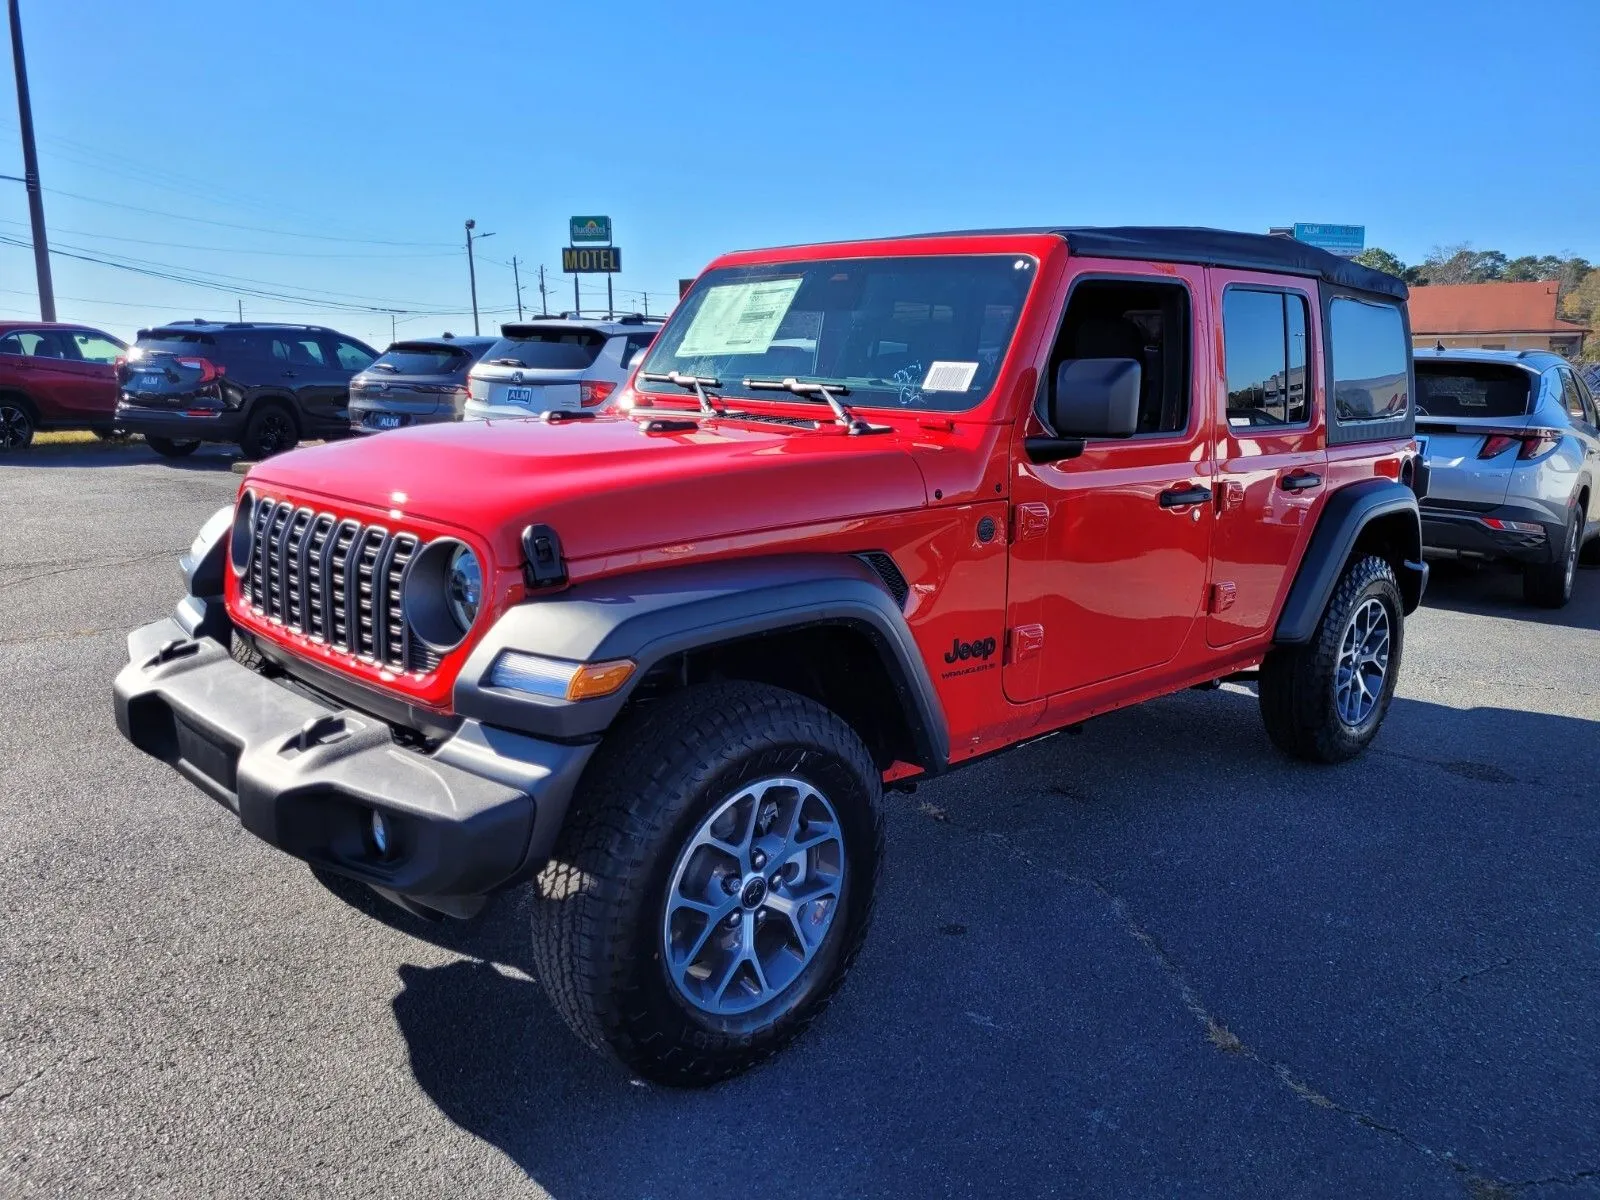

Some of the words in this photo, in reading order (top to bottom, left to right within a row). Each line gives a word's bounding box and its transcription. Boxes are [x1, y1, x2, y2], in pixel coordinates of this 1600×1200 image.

[564, 250, 618, 270] MOTEL
[142, 376, 158, 385] ALM
[508, 390, 529, 402] ALM
[380, 417, 400, 427] ALM
[944, 637, 996, 664] Jeep
